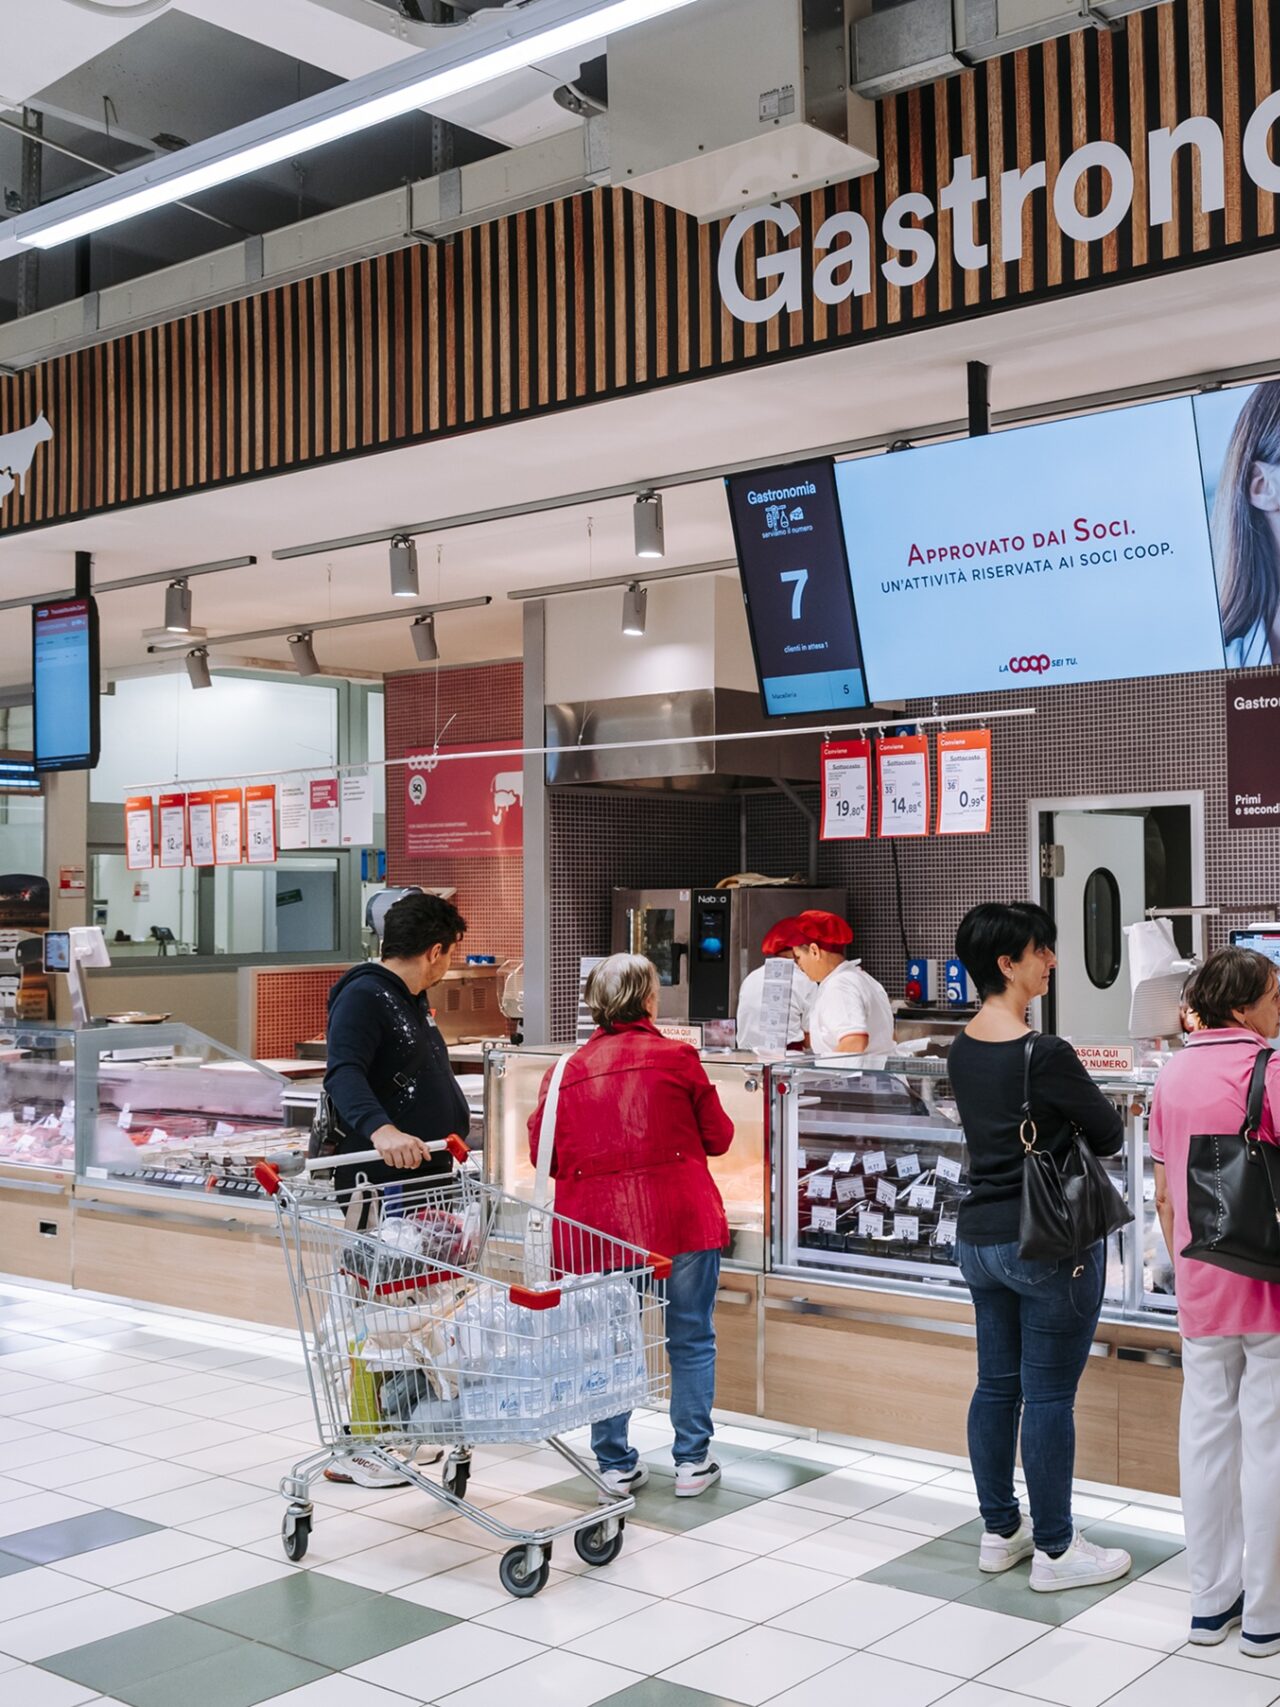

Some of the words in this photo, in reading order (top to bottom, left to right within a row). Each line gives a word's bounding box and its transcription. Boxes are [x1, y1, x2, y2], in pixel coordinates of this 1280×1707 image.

[747, 480, 816, 505] Gastronomia
[907, 535, 1025, 567] APPROVATO
[1033, 529, 1067, 547] DAI
[1073, 518, 1136, 543] SOCI.
[881, 567, 967, 594] UN'ATTIVITÀ
[972, 560, 1053, 582] RISERVATA
[1058, 557, 1075, 570] AI
[1080, 550, 1118, 567] SOCI
[1123, 541, 1174, 562] COOP.
[780, 569, 809, 620] 7
[999, 664, 1009, 674] LA
[1009, 653, 1050, 675] coop
[1051, 659, 1063, 668] SEI
[843, 684, 850, 695] 5
[879, 743, 904, 751] Conviene
[940, 738, 966, 747] Conviene
[824, 747, 848, 755] Conviene
[1235, 793, 1261, 805] Primi
[1235, 807, 1242, 816] e
[698, 895, 727, 904] Nabo
[1076, 1048, 1101, 1058] ASCIA
[1102, 1049, 1119, 1058] QUI
[1090, 1060, 1128, 1069] NUMERO
